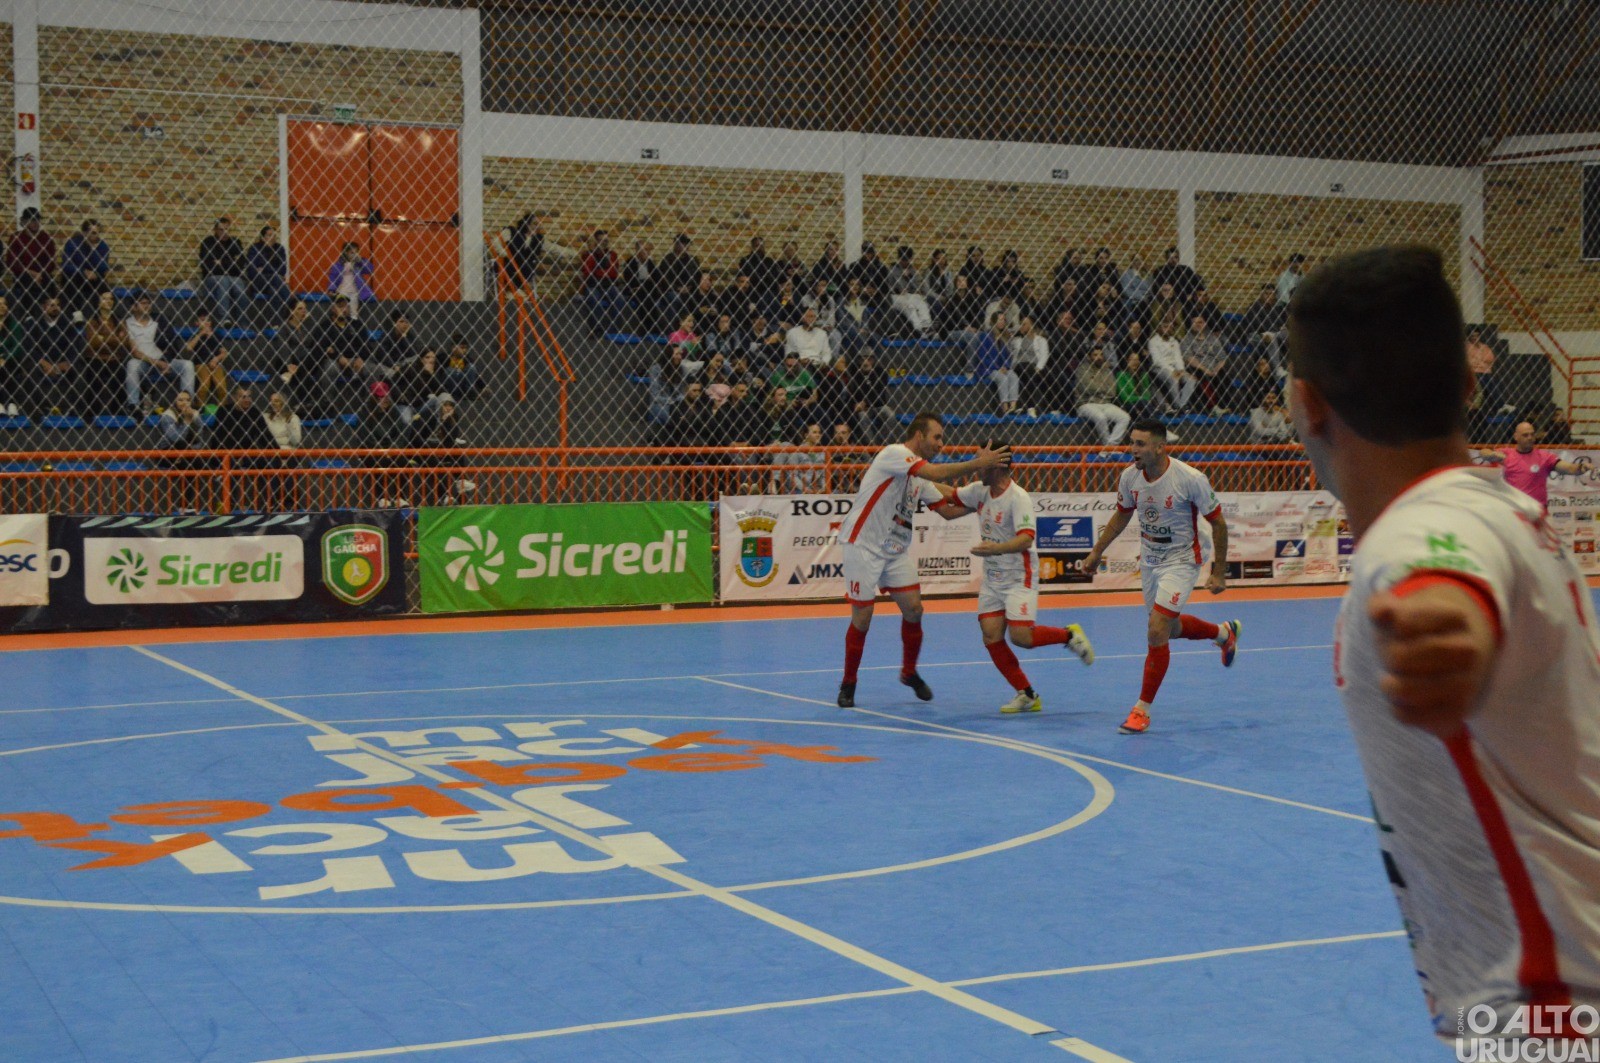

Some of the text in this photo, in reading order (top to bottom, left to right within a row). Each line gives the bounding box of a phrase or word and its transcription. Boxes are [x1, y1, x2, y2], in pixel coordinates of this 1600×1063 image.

[157, 553, 282, 587] Sicredi
[516, 529, 688, 579] Sicredi
[918, 556, 971, 569] MAZZONETTO
[807, 563, 844, 579] JMX
[307, 719, 586, 752] mr
